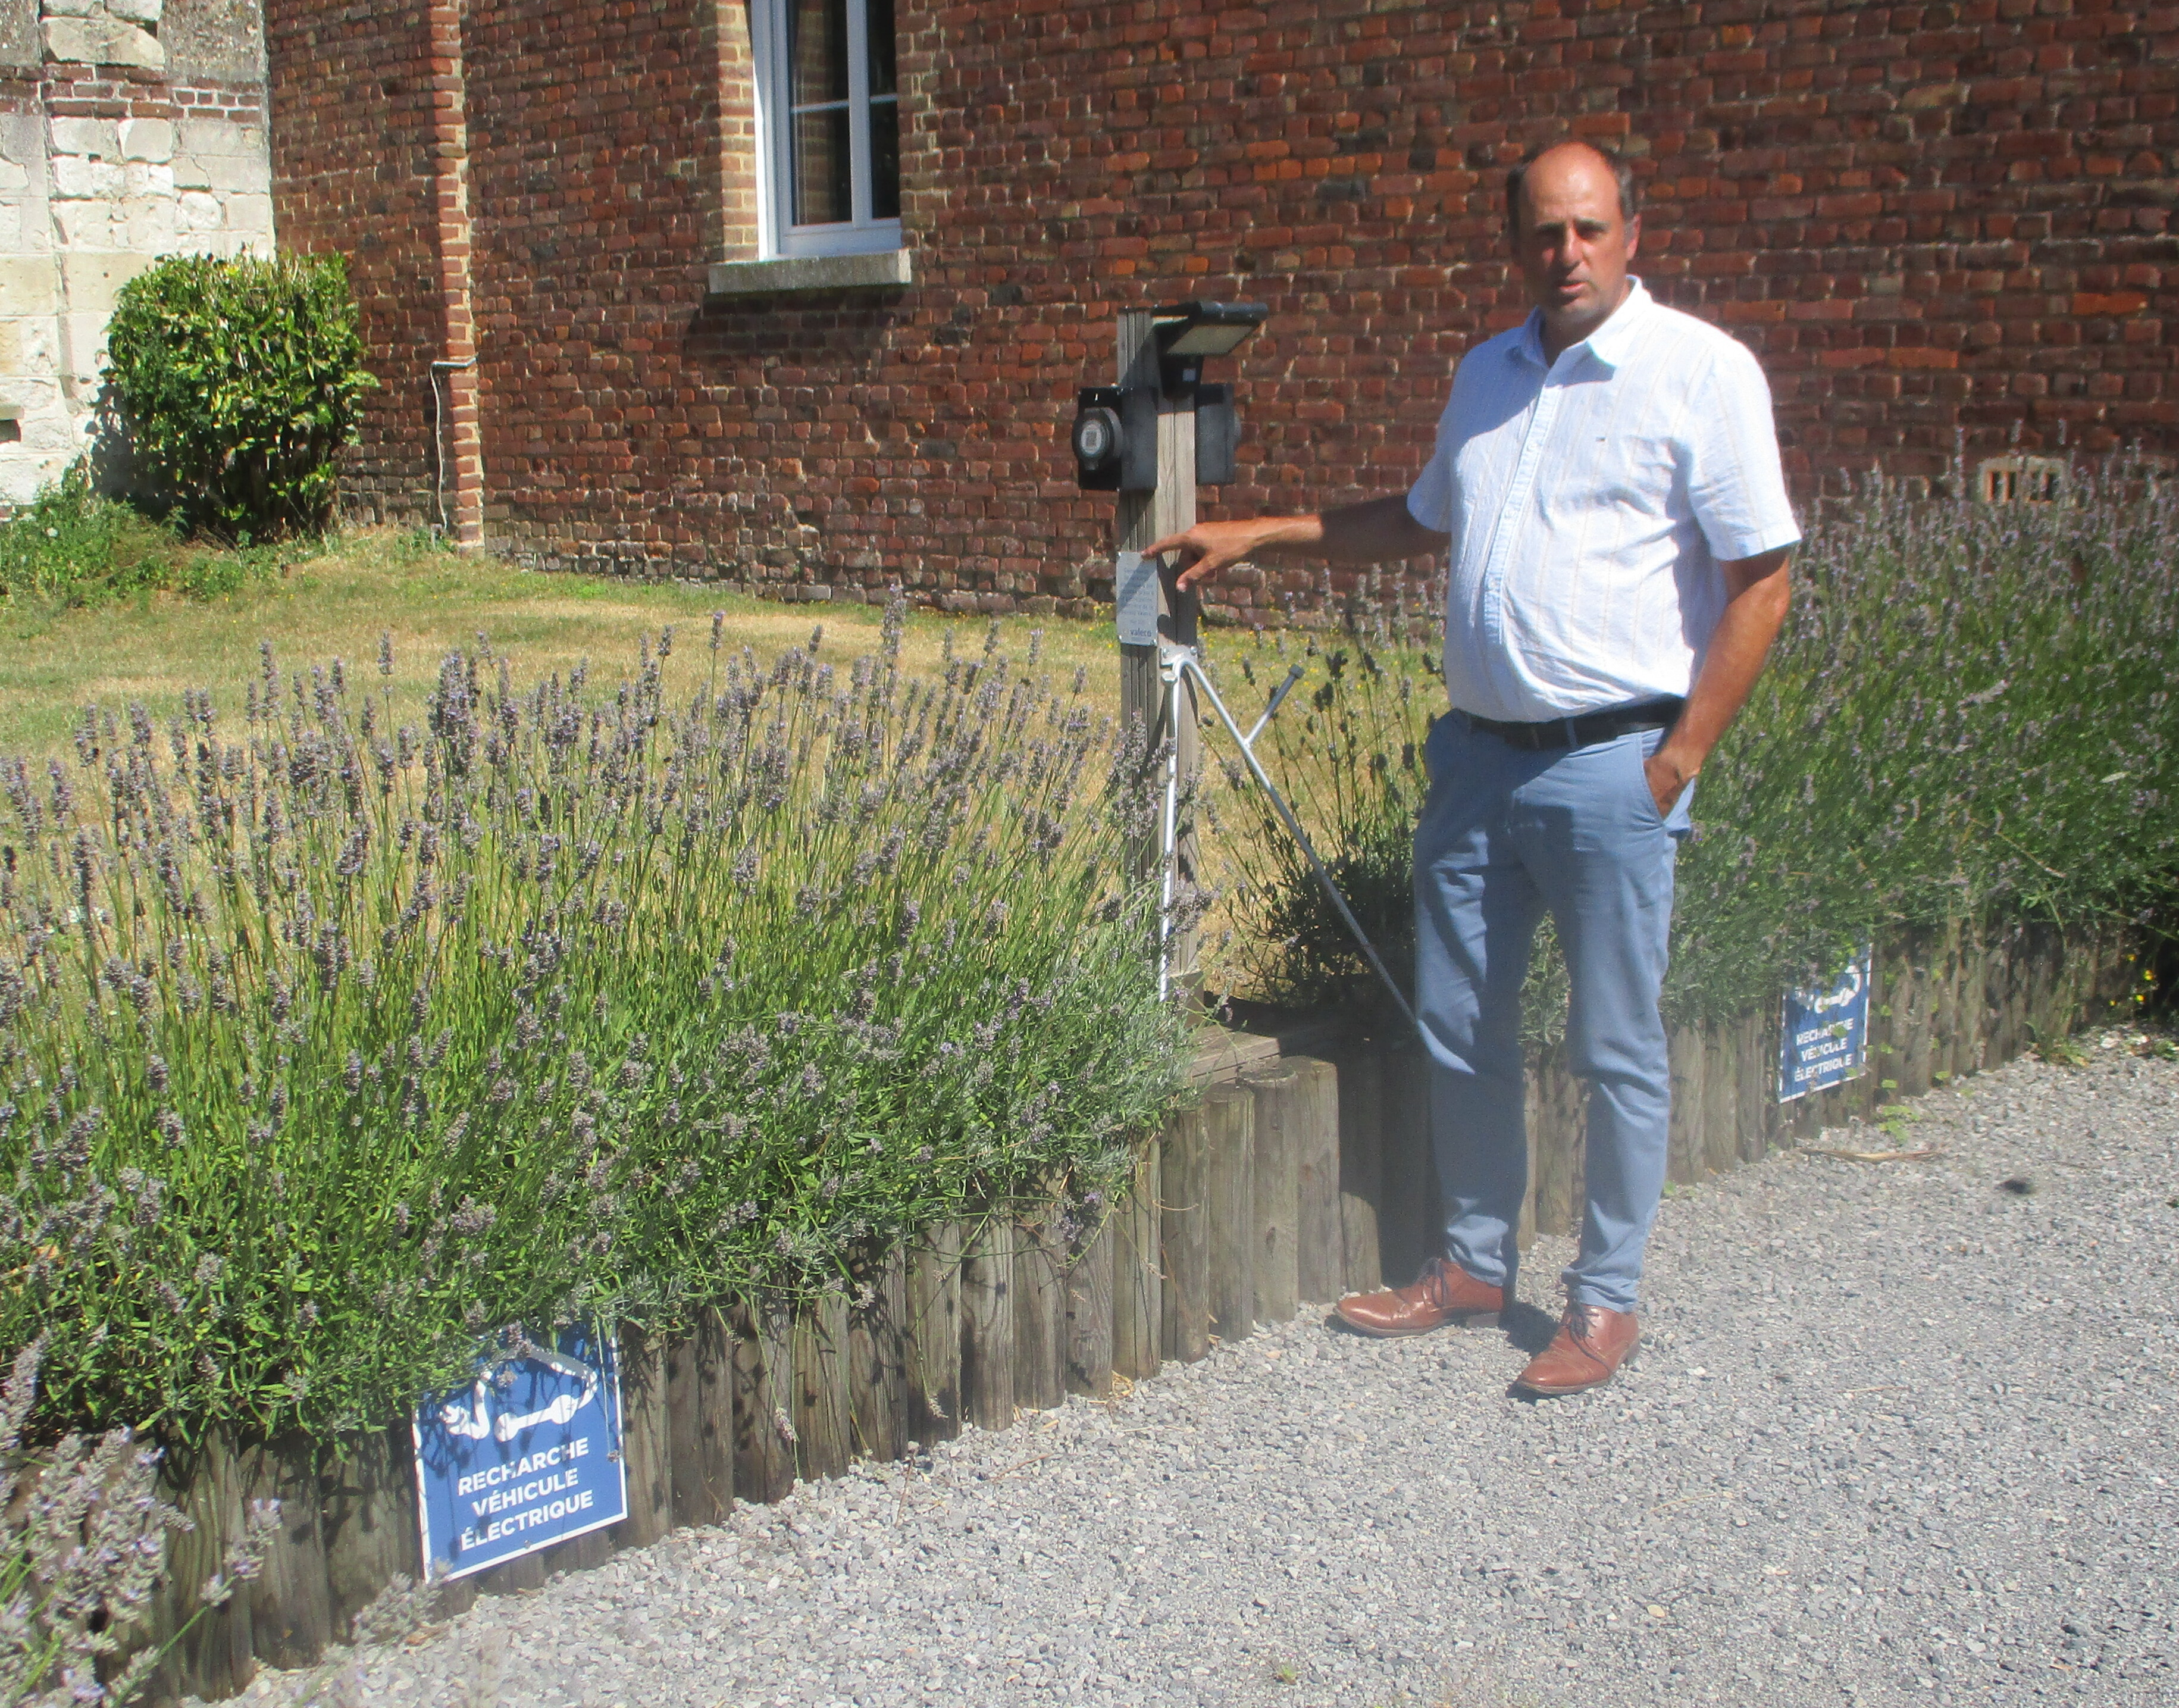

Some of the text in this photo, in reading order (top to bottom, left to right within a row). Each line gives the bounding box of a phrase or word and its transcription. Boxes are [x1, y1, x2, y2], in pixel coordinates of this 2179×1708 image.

[1796, 1018, 1854, 1046] RECHARE
[472, 1468, 578, 1517] VÉHICULE
[461, 1489, 593, 1551] ÉLECTRIQUE
